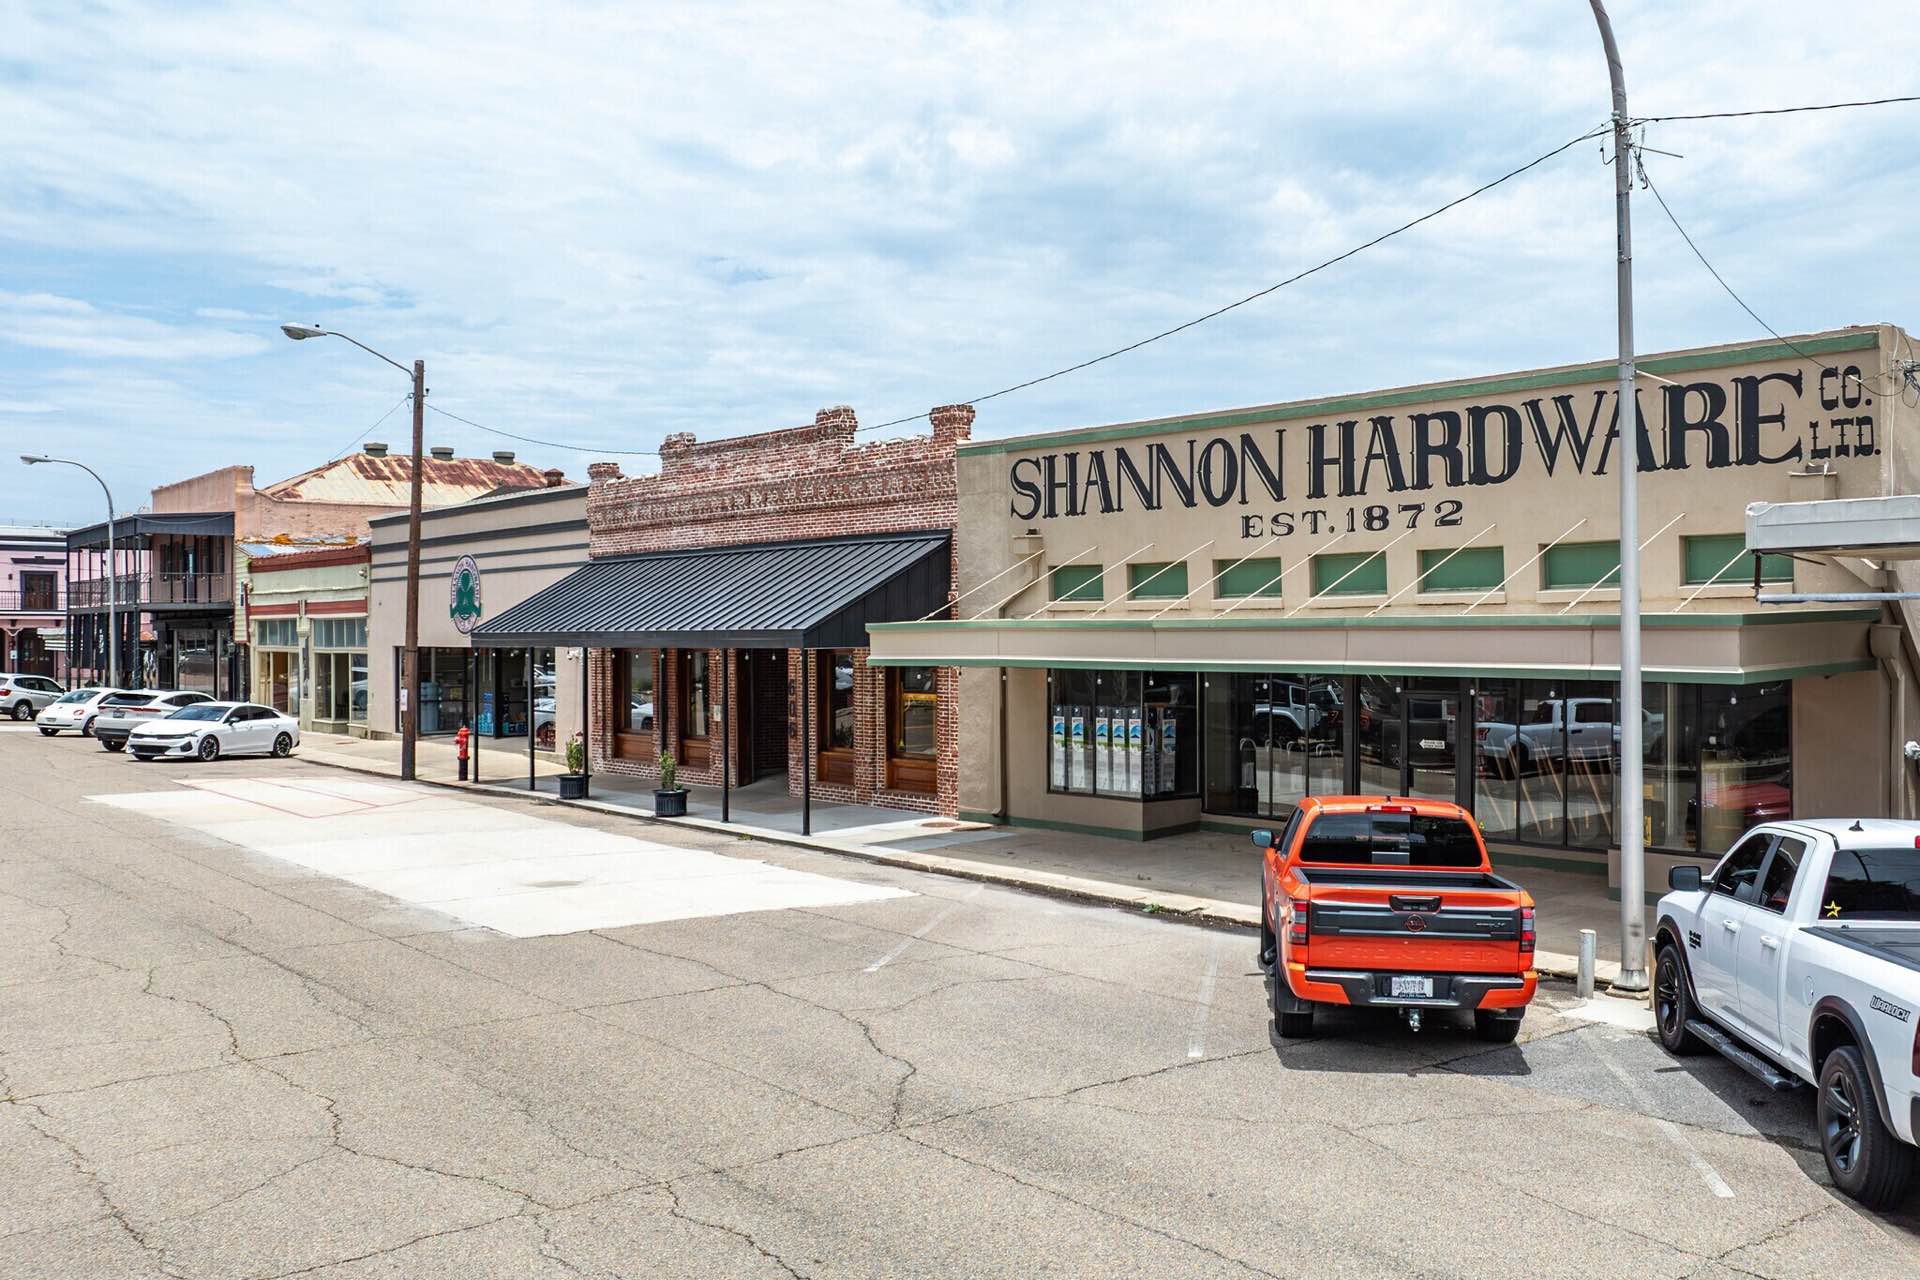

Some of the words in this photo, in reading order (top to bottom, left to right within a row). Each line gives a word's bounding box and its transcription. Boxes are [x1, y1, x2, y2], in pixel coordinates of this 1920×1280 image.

[1818, 365, 1873, 411] CO.
[1010, 428, 1287, 520] SHANNON
[1305, 368, 1803, 500] HARDWARE
[1809, 415, 1881, 460] LTD.
[1869, 995, 1911, 1023] WARLOCK
